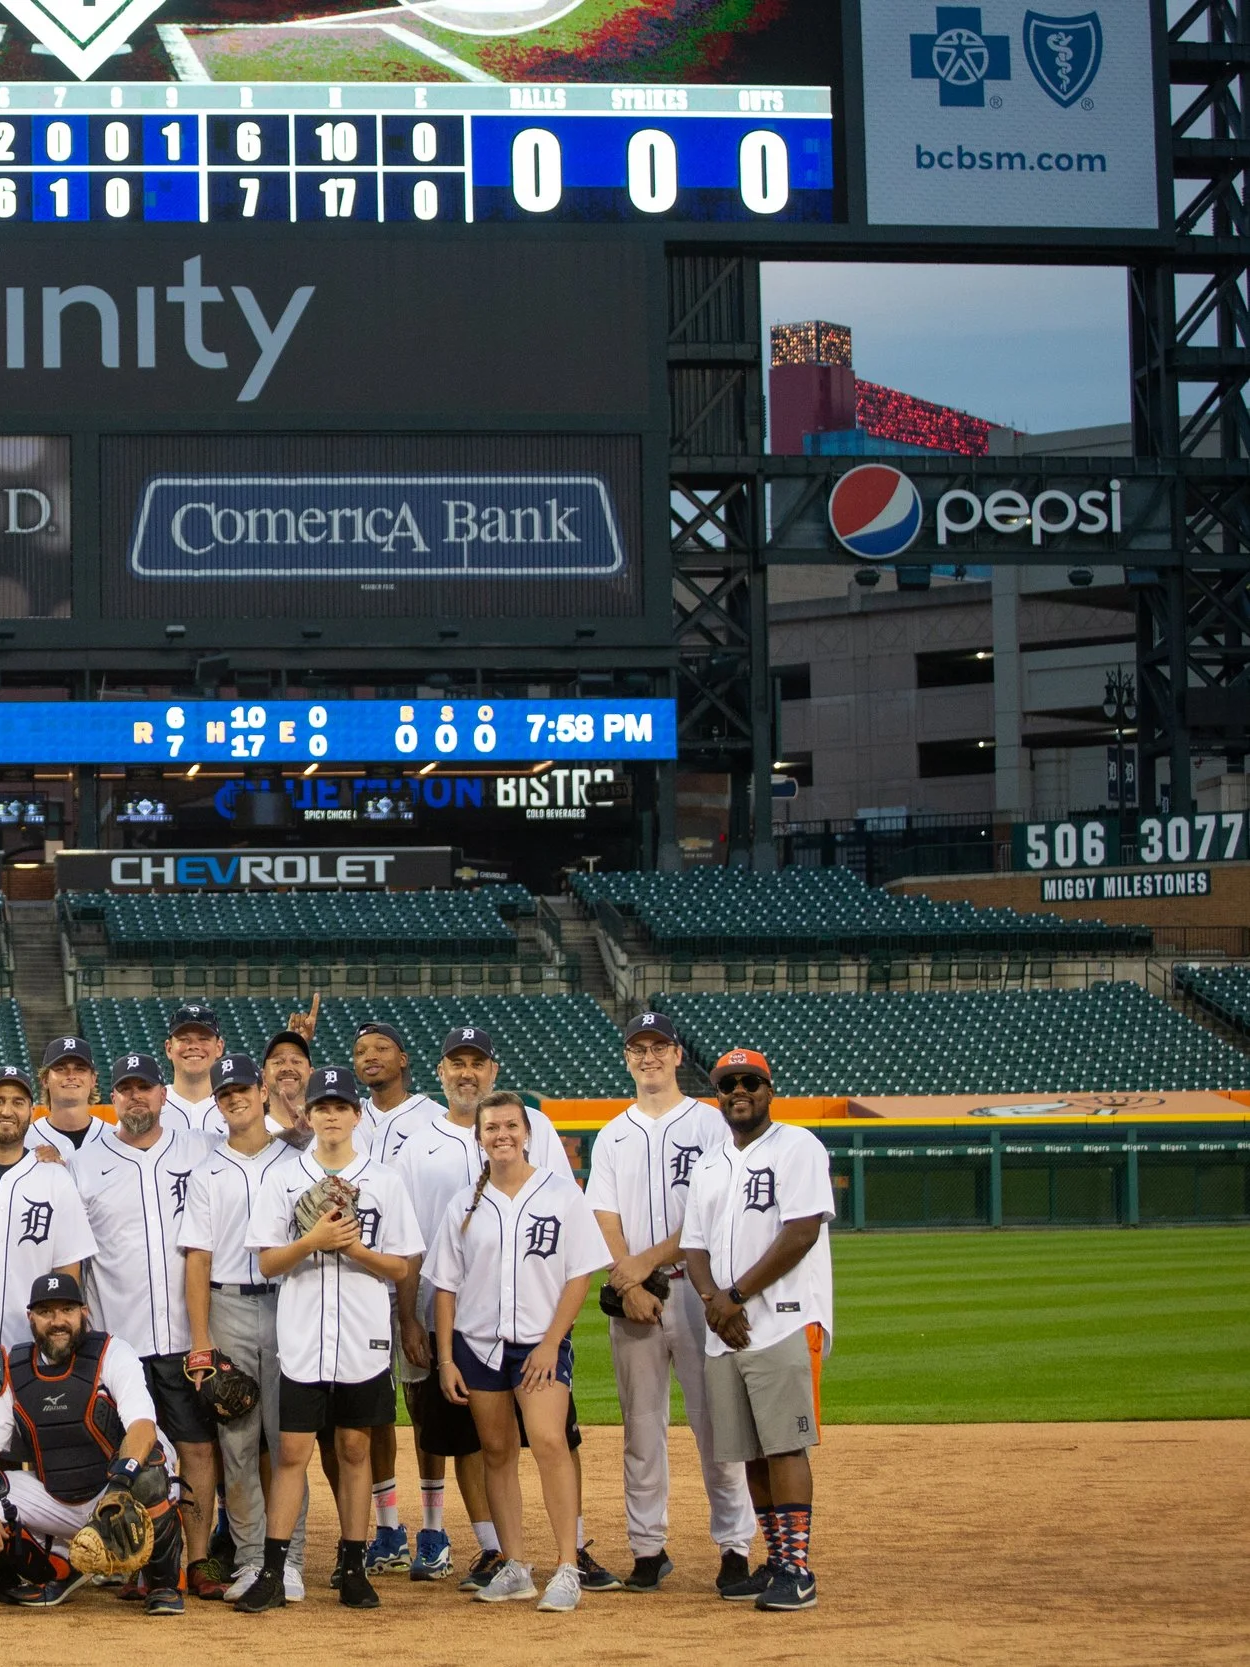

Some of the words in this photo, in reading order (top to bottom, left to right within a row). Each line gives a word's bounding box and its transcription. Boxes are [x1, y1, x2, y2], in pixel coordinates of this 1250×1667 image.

[53, 87, 66, 109] 7
[111, 87, 123, 109] 8
[166, 87, 178, 109] 9
[510, 88, 567, 110] BALLS
[612, 89, 688, 111] STRIKES
[739, 90, 784, 111] OUTS
[46, 122, 72, 163] 0
[104, 122, 129, 163] 0
[161, 122, 181, 163] 1
[236, 122, 261, 162] 6
[315, 122, 357, 162] 10
[413, 122, 437, 162] 0
[511, 128, 561, 213] 0
[627, 129, 677, 213] 0
[739, 129, 788, 214] 0
[915, 144, 1107, 172] bcbsm.com
[50, 178, 69, 219] 1
[105, 178, 130, 219] 0
[239, 178, 259, 217] 7
[319, 178, 356, 218] 17
[414, 180, 438, 220] 0
[442, 499, 582, 543] Bank
[936, 479, 1122, 545] pepsi
[166, 706, 186, 729] 6
[231, 706, 267, 729] 10
[308, 706, 328, 728] 0
[440, 705, 454, 722] S
[526, 714, 594, 743] 7:58
[603, 713, 653, 742] PM
[133, 722, 154, 744] R
[206, 721, 226, 743] H
[279, 721, 296, 743] E
[166, 735, 184, 757] 7
[231, 735, 266, 757] 17
[308, 734, 328, 757] 0
[395, 724, 418, 753] 0
[435, 724, 458, 753] 0
[473, 724, 496, 753] 0
[304, 810, 325, 820] SPICY
[526, 809, 544, 819] COLD
[546, 809, 586, 819] BEVERAGES
[1026, 821, 1105, 869] 506
[1140, 813, 1244, 864] 3077
[111, 854, 396, 886] CHEVROLET
[1043, 877, 1096, 901] MIGGY
[1103, 872, 1208, 898] MILESTONES
[847, 1149, 875, 1157] @tigers
[887, 1148, 914, 1157] @tigers
[926, 1148, 953, 1157] @tigers
[967, 1147, 994, 1155] @tigers
[1006, 1145, 1032, 1153] @tigers
[1045, 1145, 1071, 1153] @tigers
[1083, 1144, 1110, 1153] @tigers
[1122, 1143, 1148, 1152] @tigers
[1160, 1143, 1187, 1152] @tigers
[1199, 1142, 1225, 1151] @tigers
[17, 1195, 54, 1247] D
[523, 1212, 561, 1261] D
